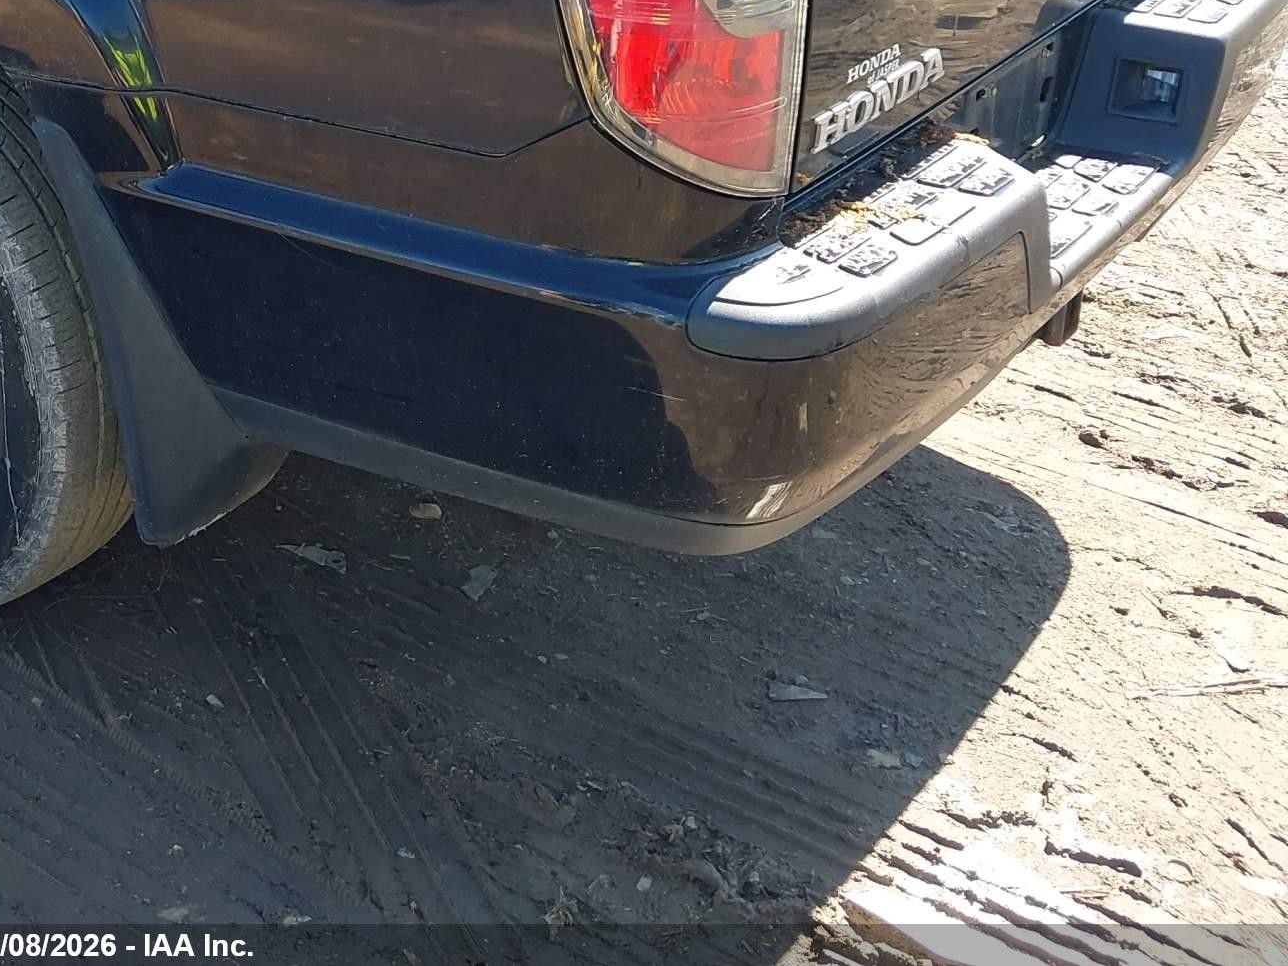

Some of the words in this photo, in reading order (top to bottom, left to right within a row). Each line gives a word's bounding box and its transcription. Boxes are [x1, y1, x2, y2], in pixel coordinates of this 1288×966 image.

[846, 43, 901, 84] HONDA
[875, 58, 900, 80] JASPER
[810, 48, 945, 154] HONDA
